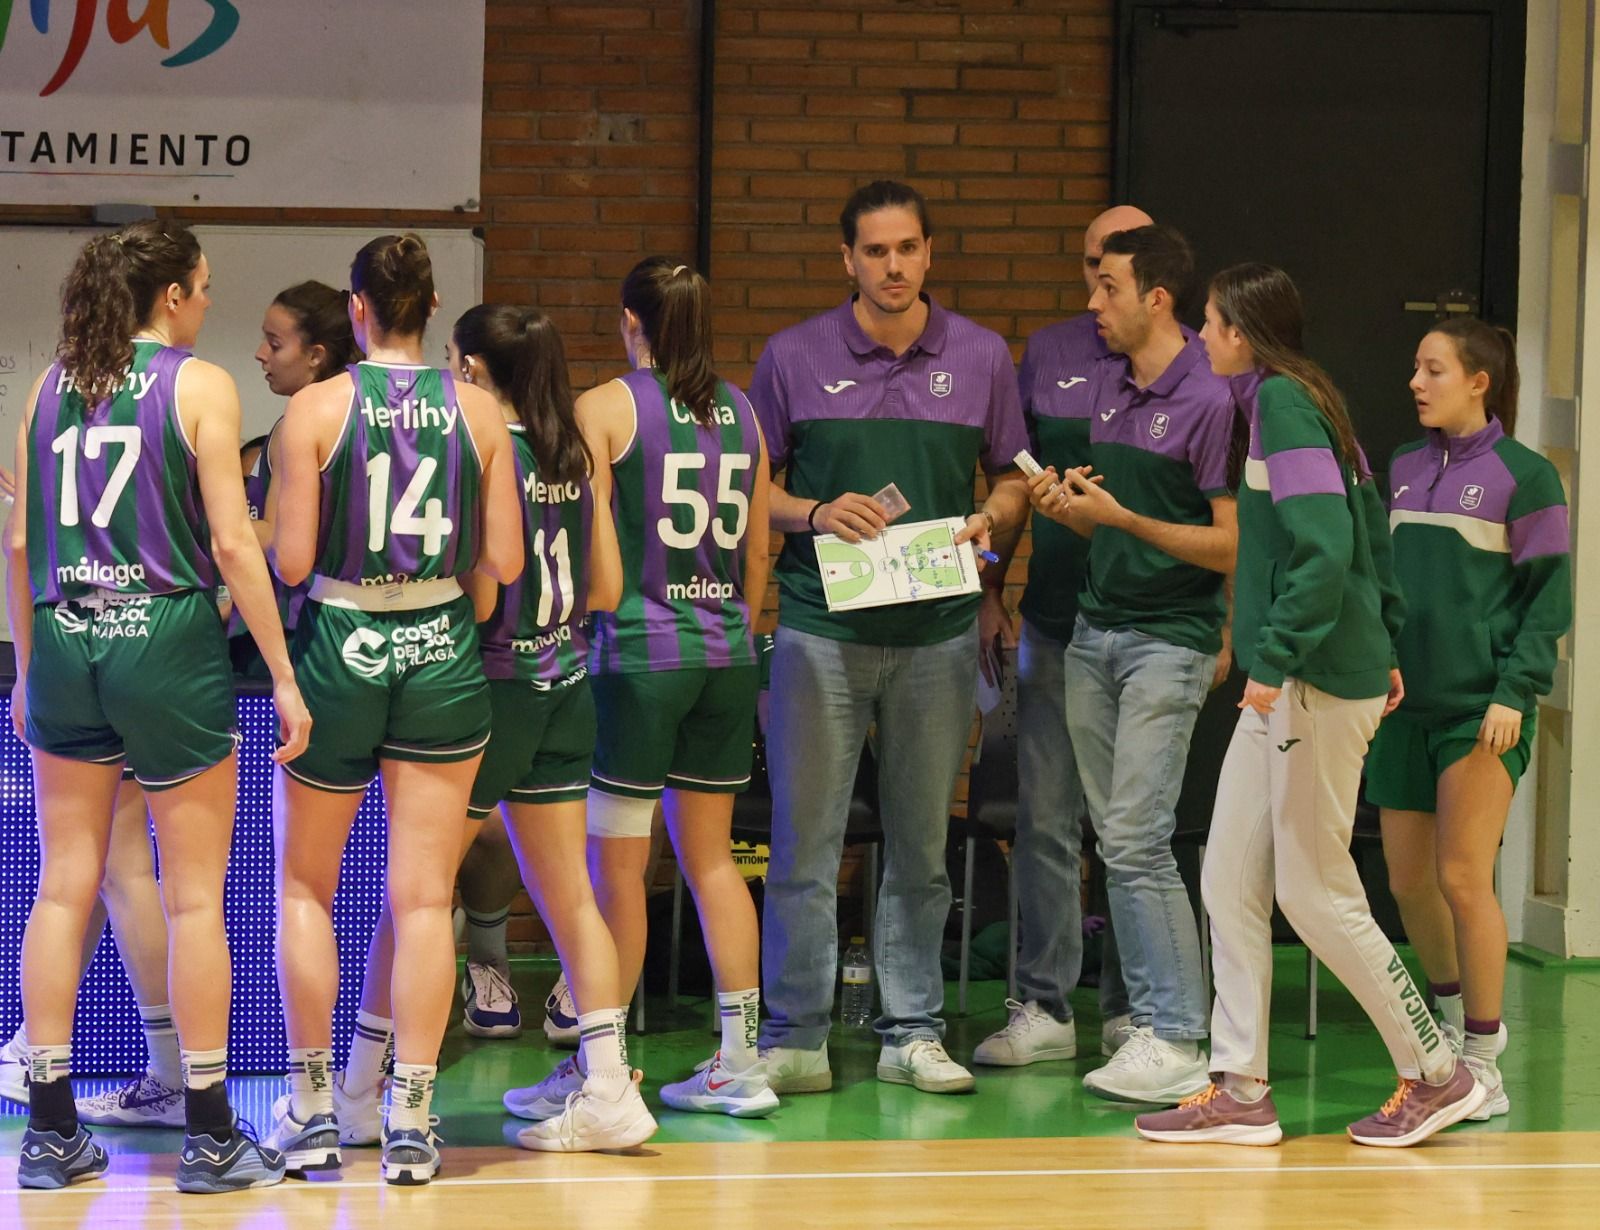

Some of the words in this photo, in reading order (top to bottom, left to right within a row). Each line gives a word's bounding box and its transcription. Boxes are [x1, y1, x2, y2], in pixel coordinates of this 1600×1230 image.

[0, 131, 250, 167] TAMIENTO
[51, 425, 142, 528] 17
[366, 451, 454, 557] 14
[657, 453, 751, 549] 55
[533, 527, 575, 628] 11
[391, 614, 450, 644] COSTA
[743, 1001, 757, 1049] UNICAJA
[1387, 953, 1440, 1055] UNICAJA
